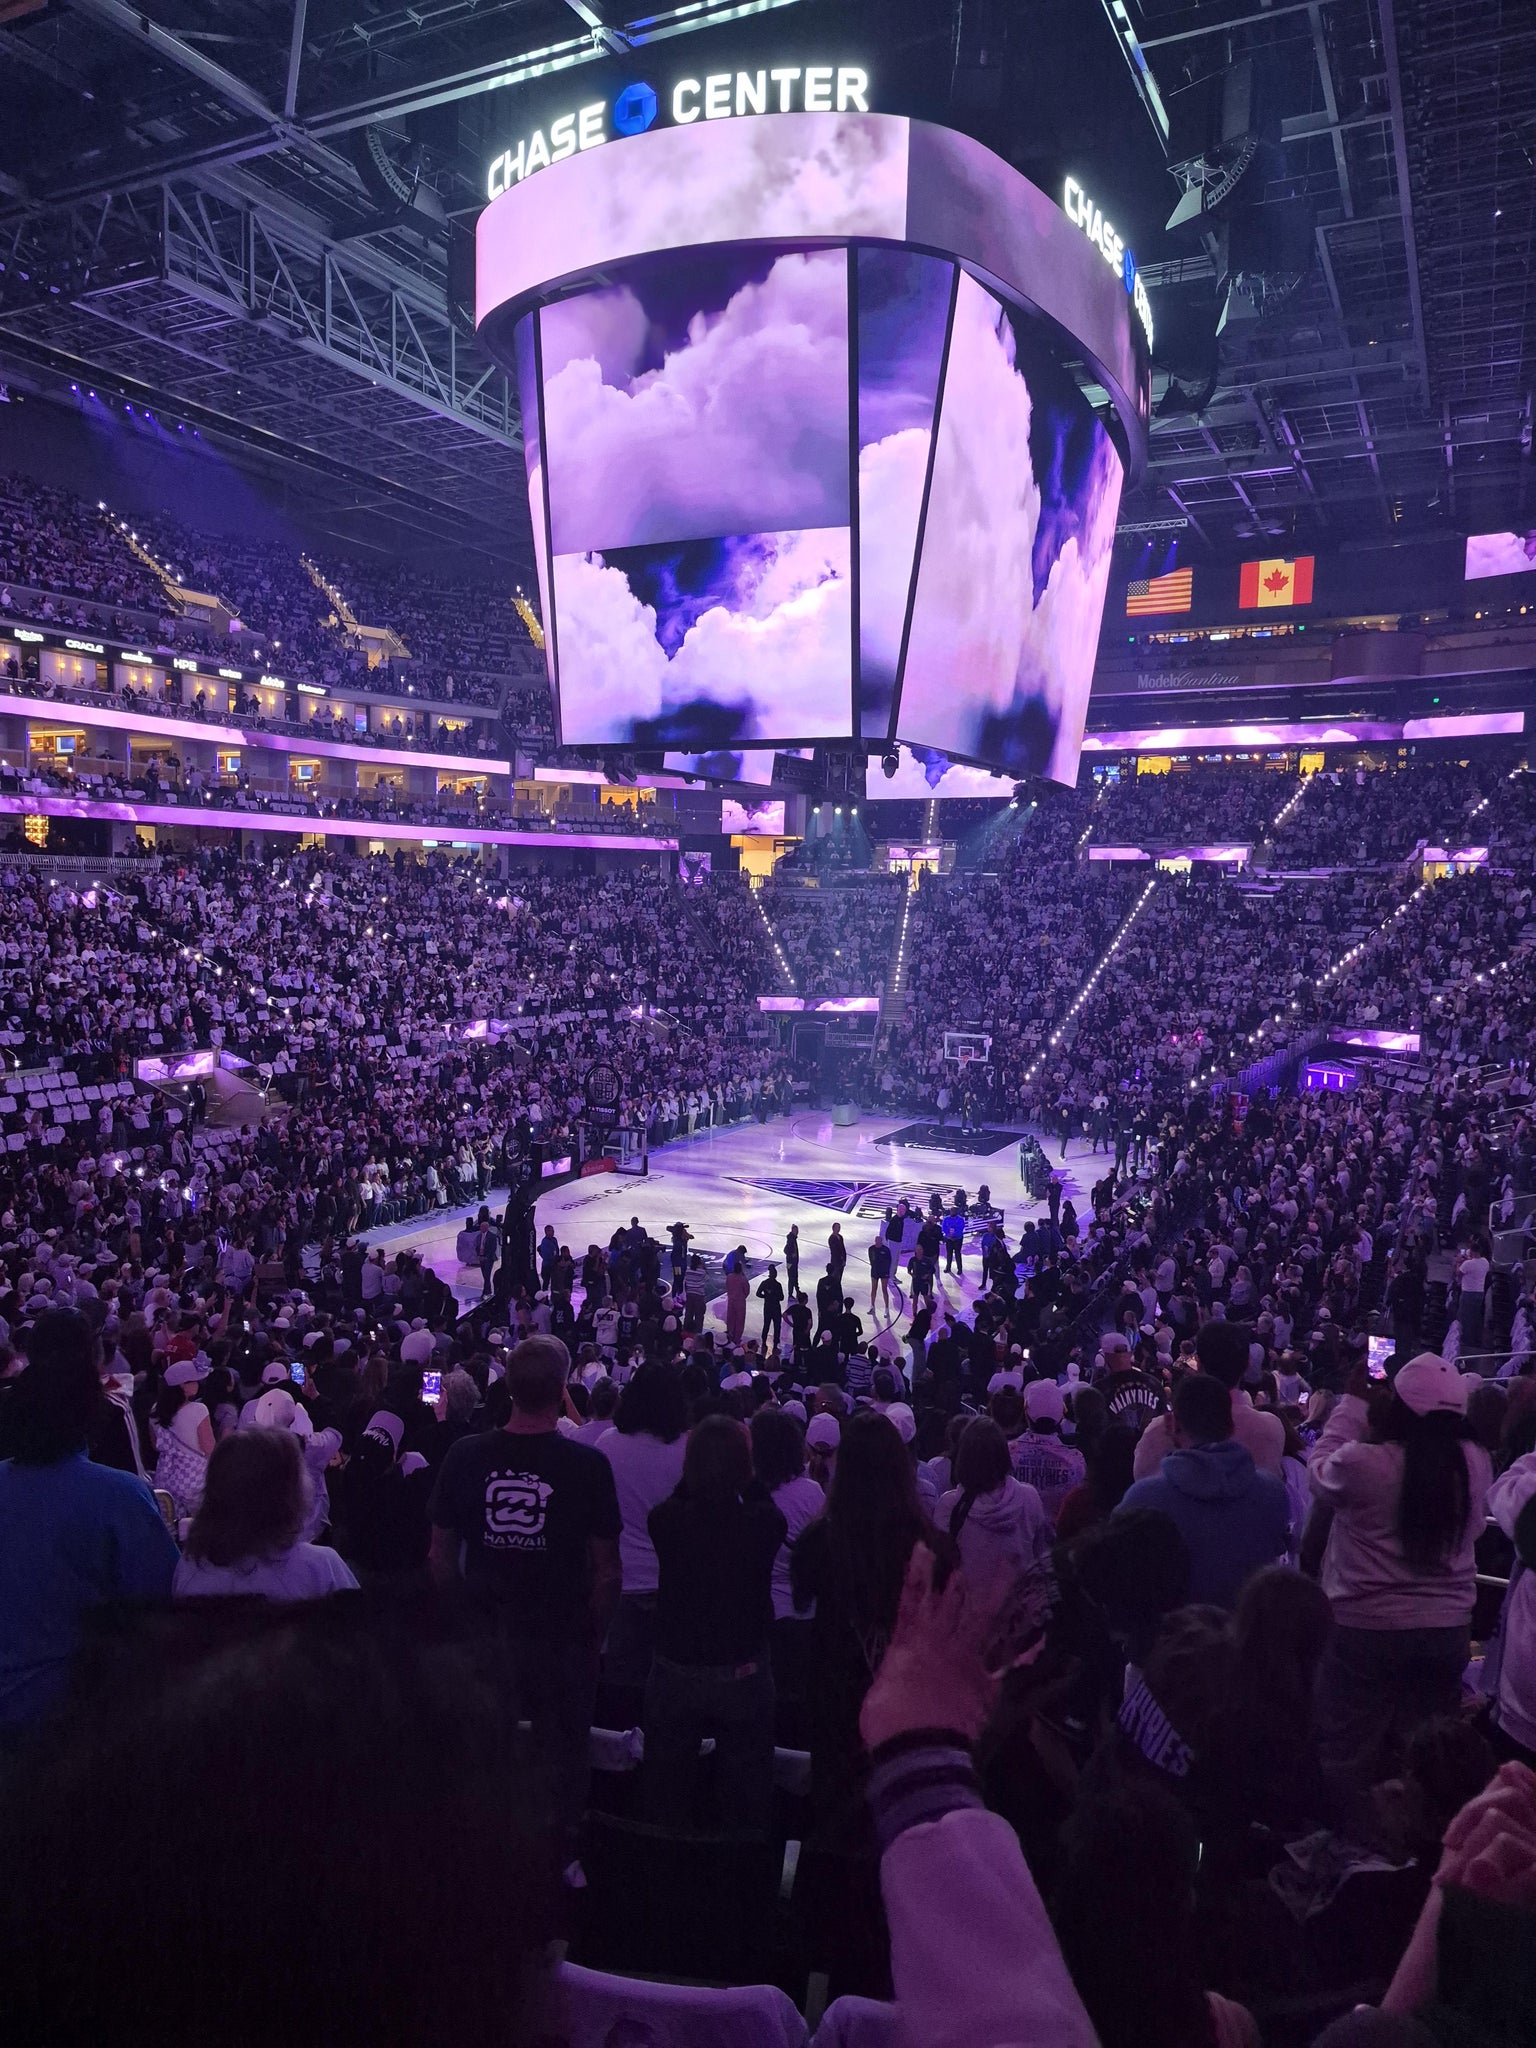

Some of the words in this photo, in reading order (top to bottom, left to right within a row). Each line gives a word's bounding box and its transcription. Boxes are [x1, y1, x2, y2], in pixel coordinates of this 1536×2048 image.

[487, 100, 607, 202] CHASE
[671, 66, 870, 125] CENTER
[1063, 175, 1124, 279] CHASE
[65, 639, 104, 653] ORACLE
[173, 657, 198, 672] HPE
[1137, 674, 1179, 689] Modelo
[1108, 1388, 1160, 1415] VALKYRIES
